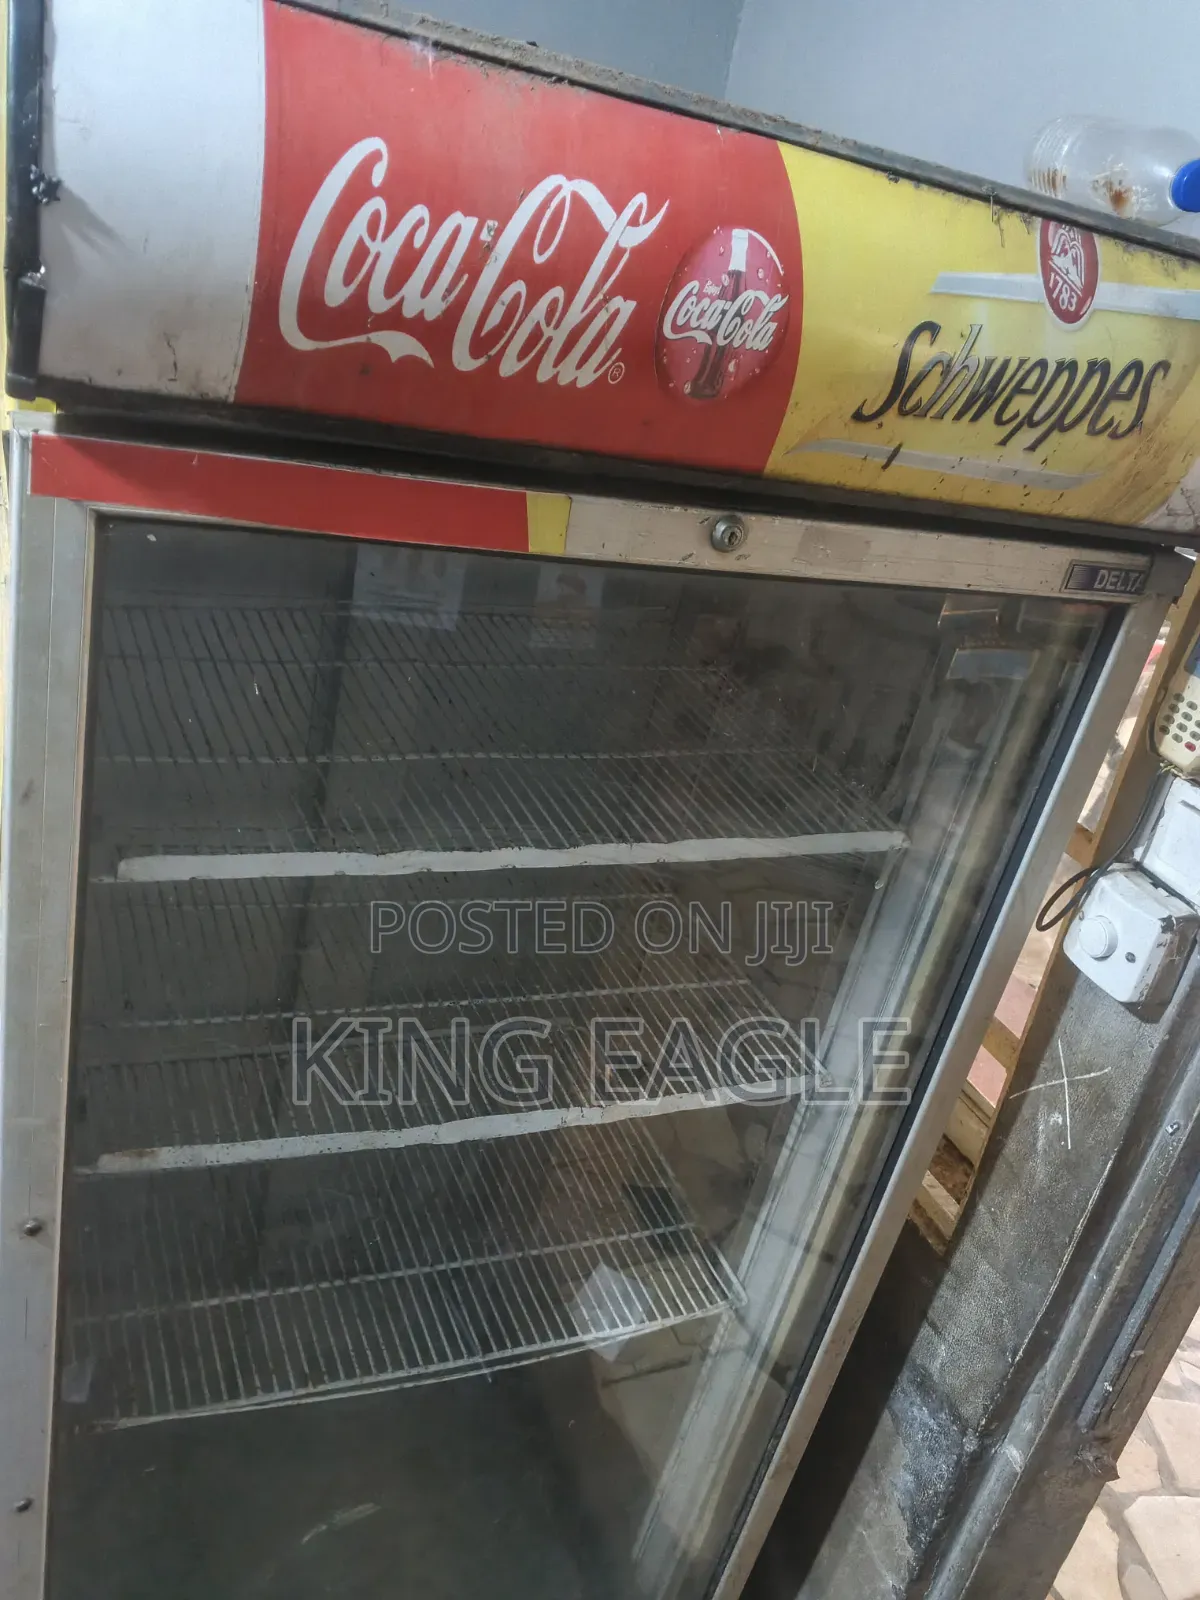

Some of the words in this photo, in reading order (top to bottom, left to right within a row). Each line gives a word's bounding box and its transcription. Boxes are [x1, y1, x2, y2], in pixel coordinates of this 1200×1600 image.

[279, 136, 670, 388] Coca-Cola
[1049, 271, 1077, 311] 1783
[662, 280, 789, 351] Coca-Cola
[851, 320, 1171, 452] Schweppes
